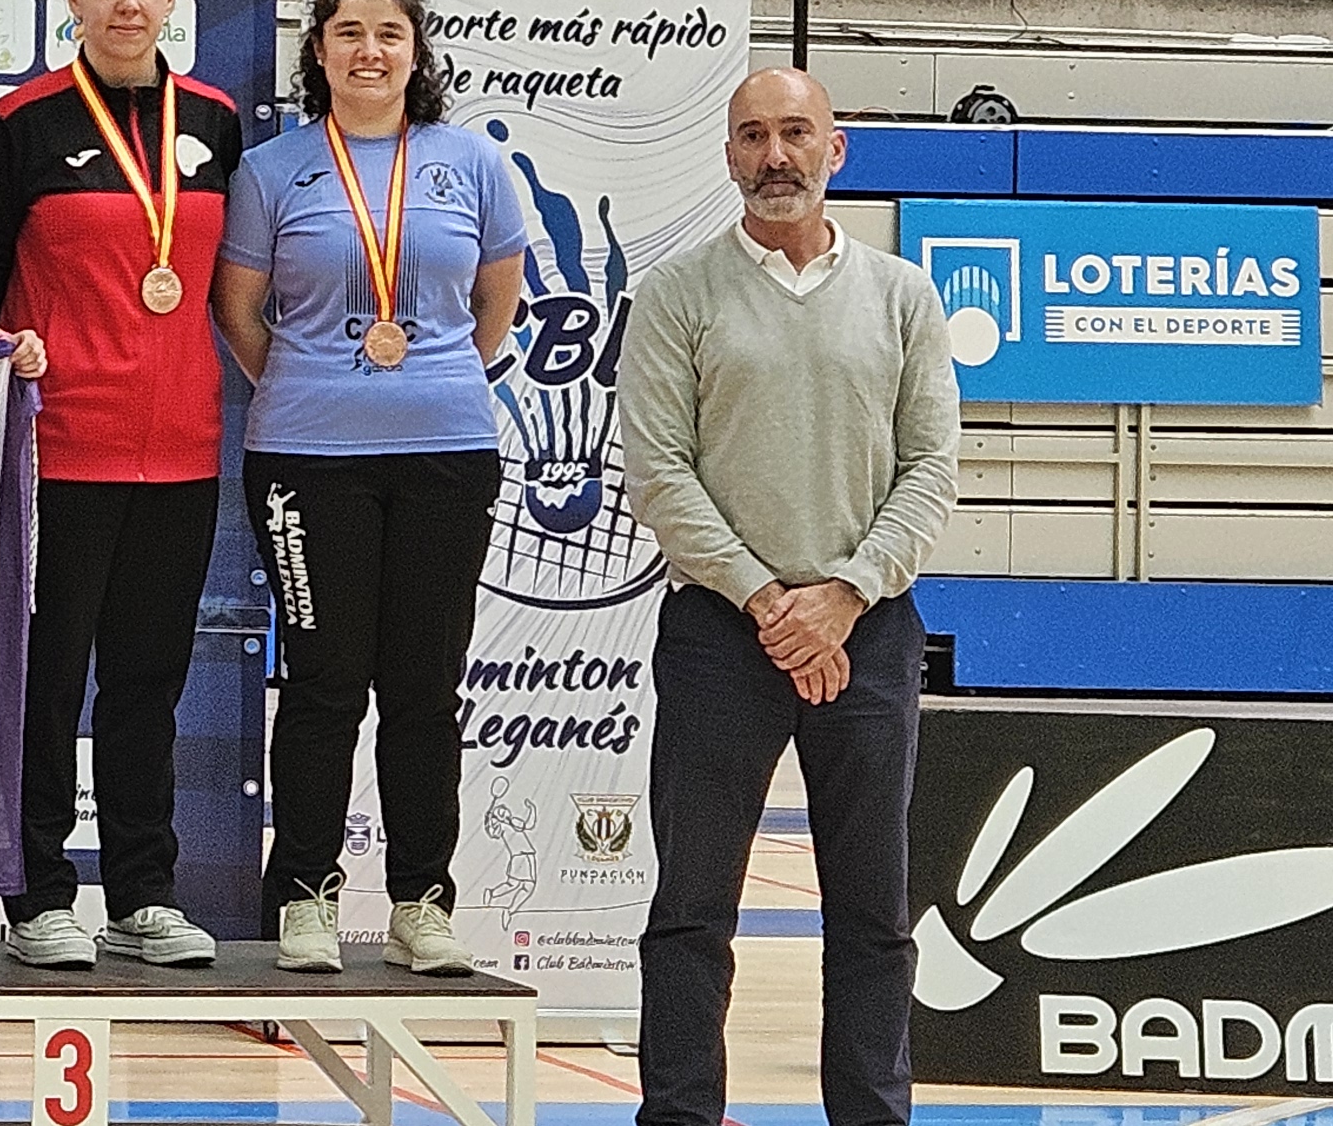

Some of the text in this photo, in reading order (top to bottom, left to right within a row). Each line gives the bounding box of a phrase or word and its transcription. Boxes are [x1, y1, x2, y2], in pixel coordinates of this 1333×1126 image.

[425, 5, 728, 61] porte más rápido
[482, 65, 624, 111] raqueta
[1044, 246, 1301, 298] LOTERÍAS
[1075, 316, 1272, 336] CON EL DEPORTE
[539, 460, 589, 483] 1995
[272, 534, 298, 626] PALENCIA
[465, 645, 642, 692] minton
[43, 1027, 95, 1126] 3
